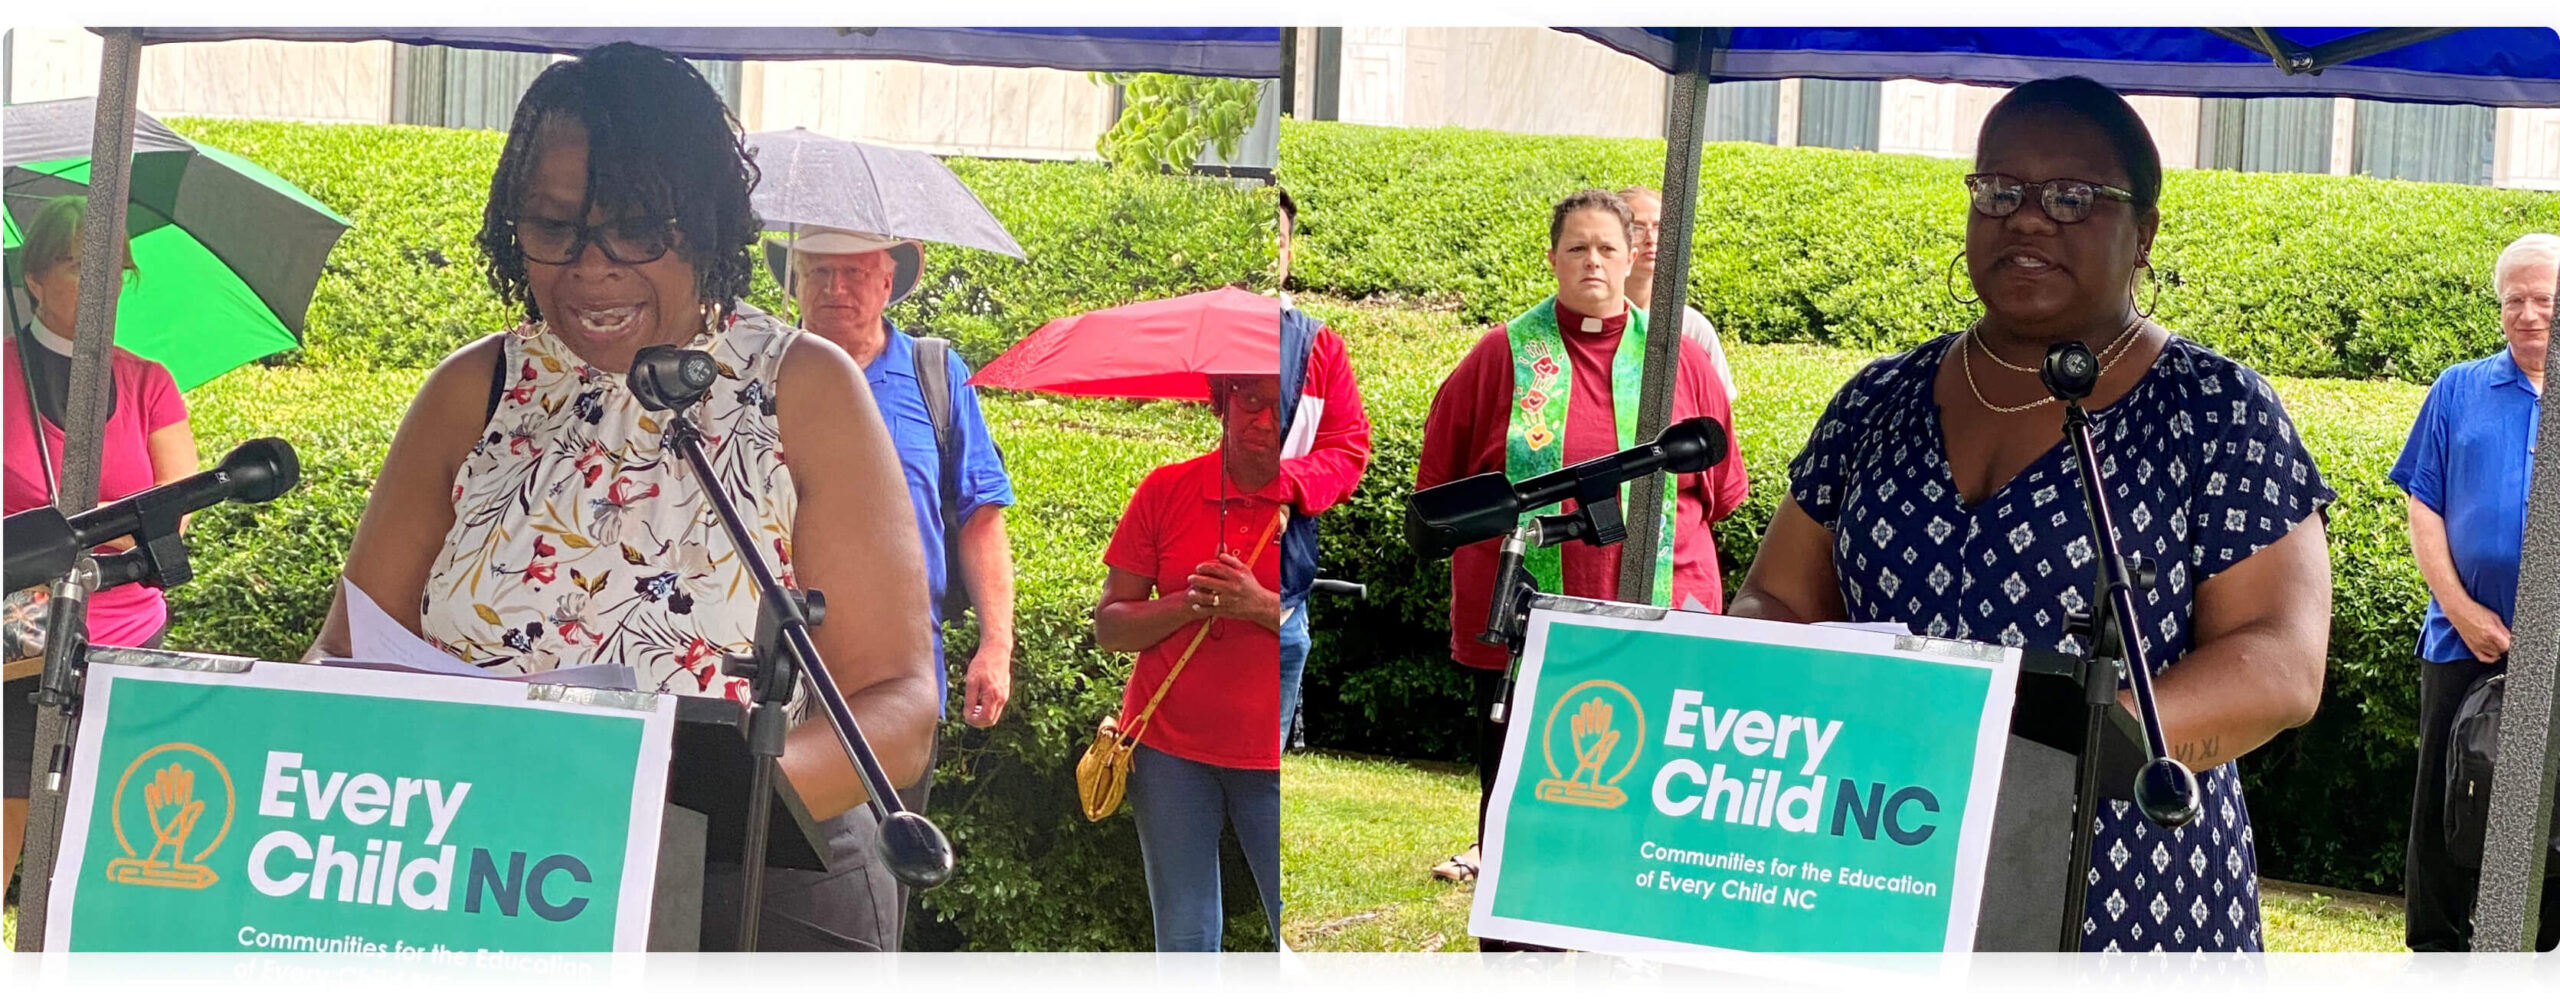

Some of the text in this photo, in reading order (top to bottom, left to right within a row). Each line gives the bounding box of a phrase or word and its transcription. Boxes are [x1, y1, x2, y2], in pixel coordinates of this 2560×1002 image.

[1663, 688, 1844, 776] Every
[258, 750, 473, 846] Every
[1651, 758, 1940, 847] Child NC
[247, 829, 593, 923] Child NC
[1635, 869, 1818, 911] of Every Child NC
[1640, 841, 1938, 898] Communities for the Education
[237, 925, 389, 959] Communities
[395, 939, 426, 962] for
[431, 943, 468, 968] the
